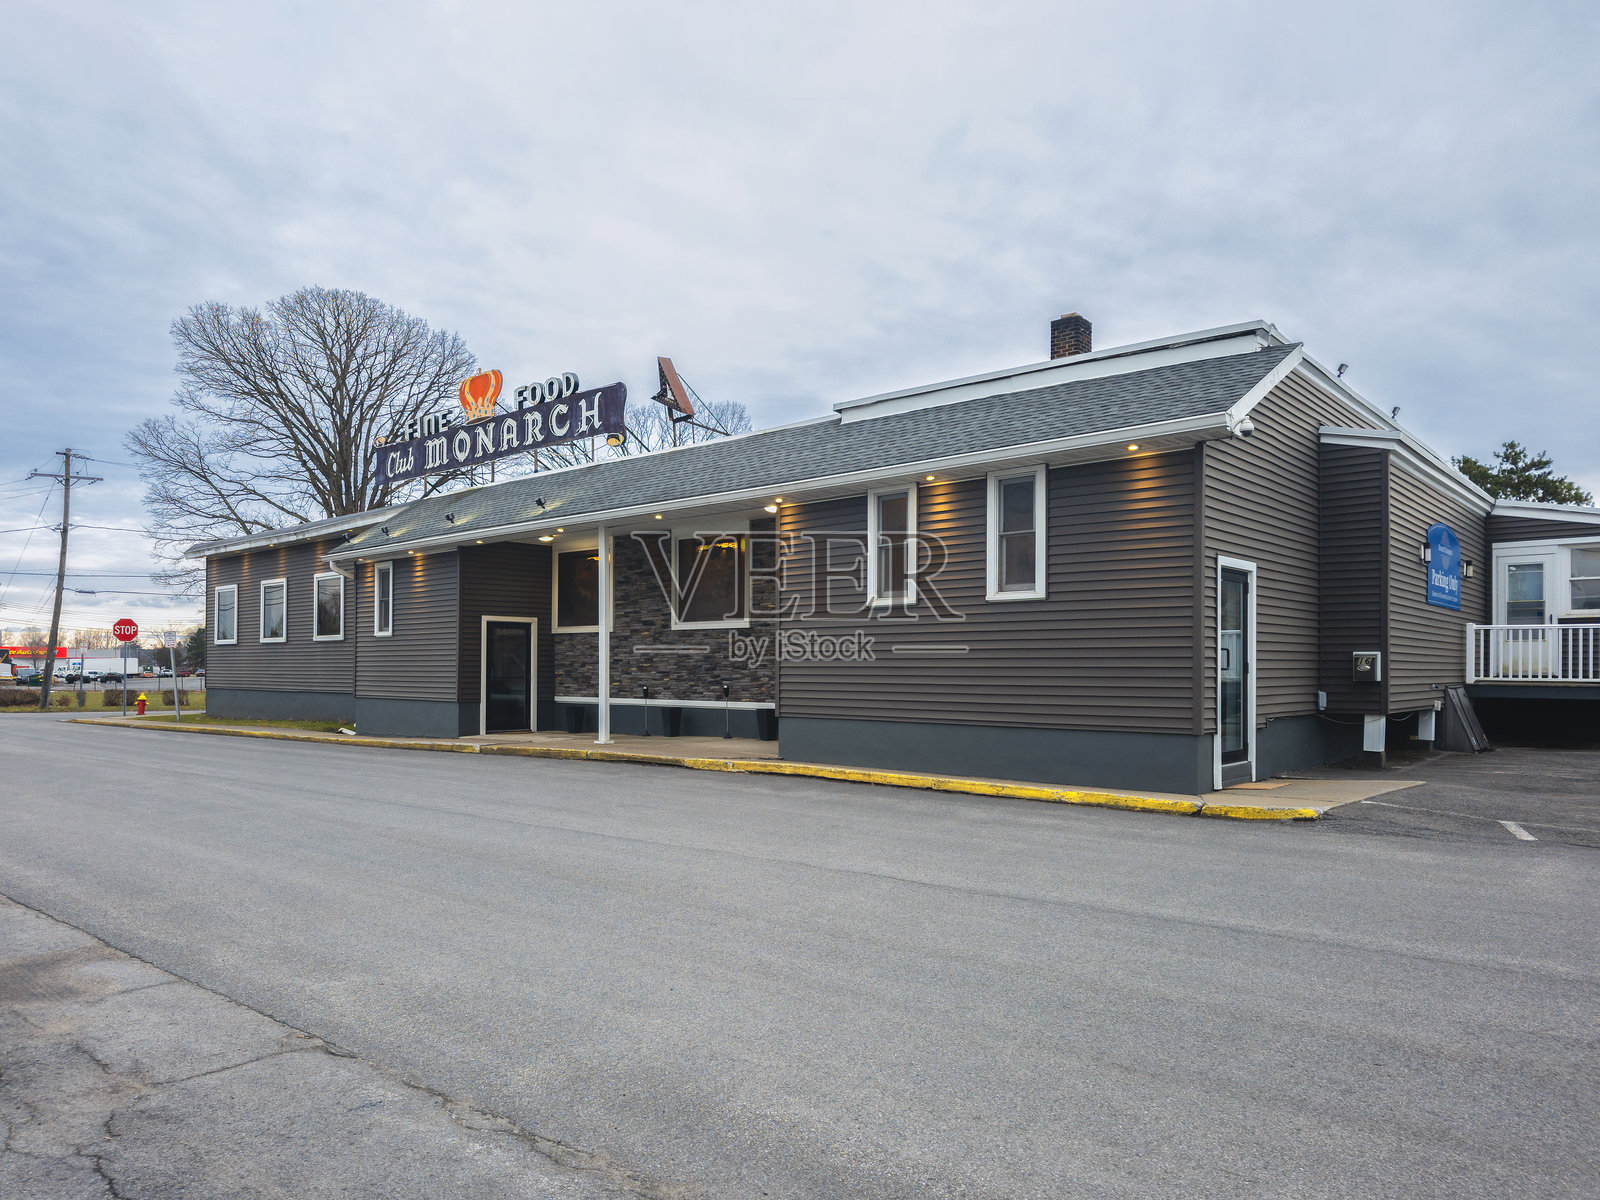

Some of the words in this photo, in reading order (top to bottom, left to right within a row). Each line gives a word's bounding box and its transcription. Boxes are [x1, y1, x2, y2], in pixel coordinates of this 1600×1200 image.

[386, 446, 414, 478] Club
[423, 391, 603, 470] MONARCH
[404, 409, 452, 442] FINE
[513, 371, 579, 411] FOOD
[114, 625, 138, 635] STOP
